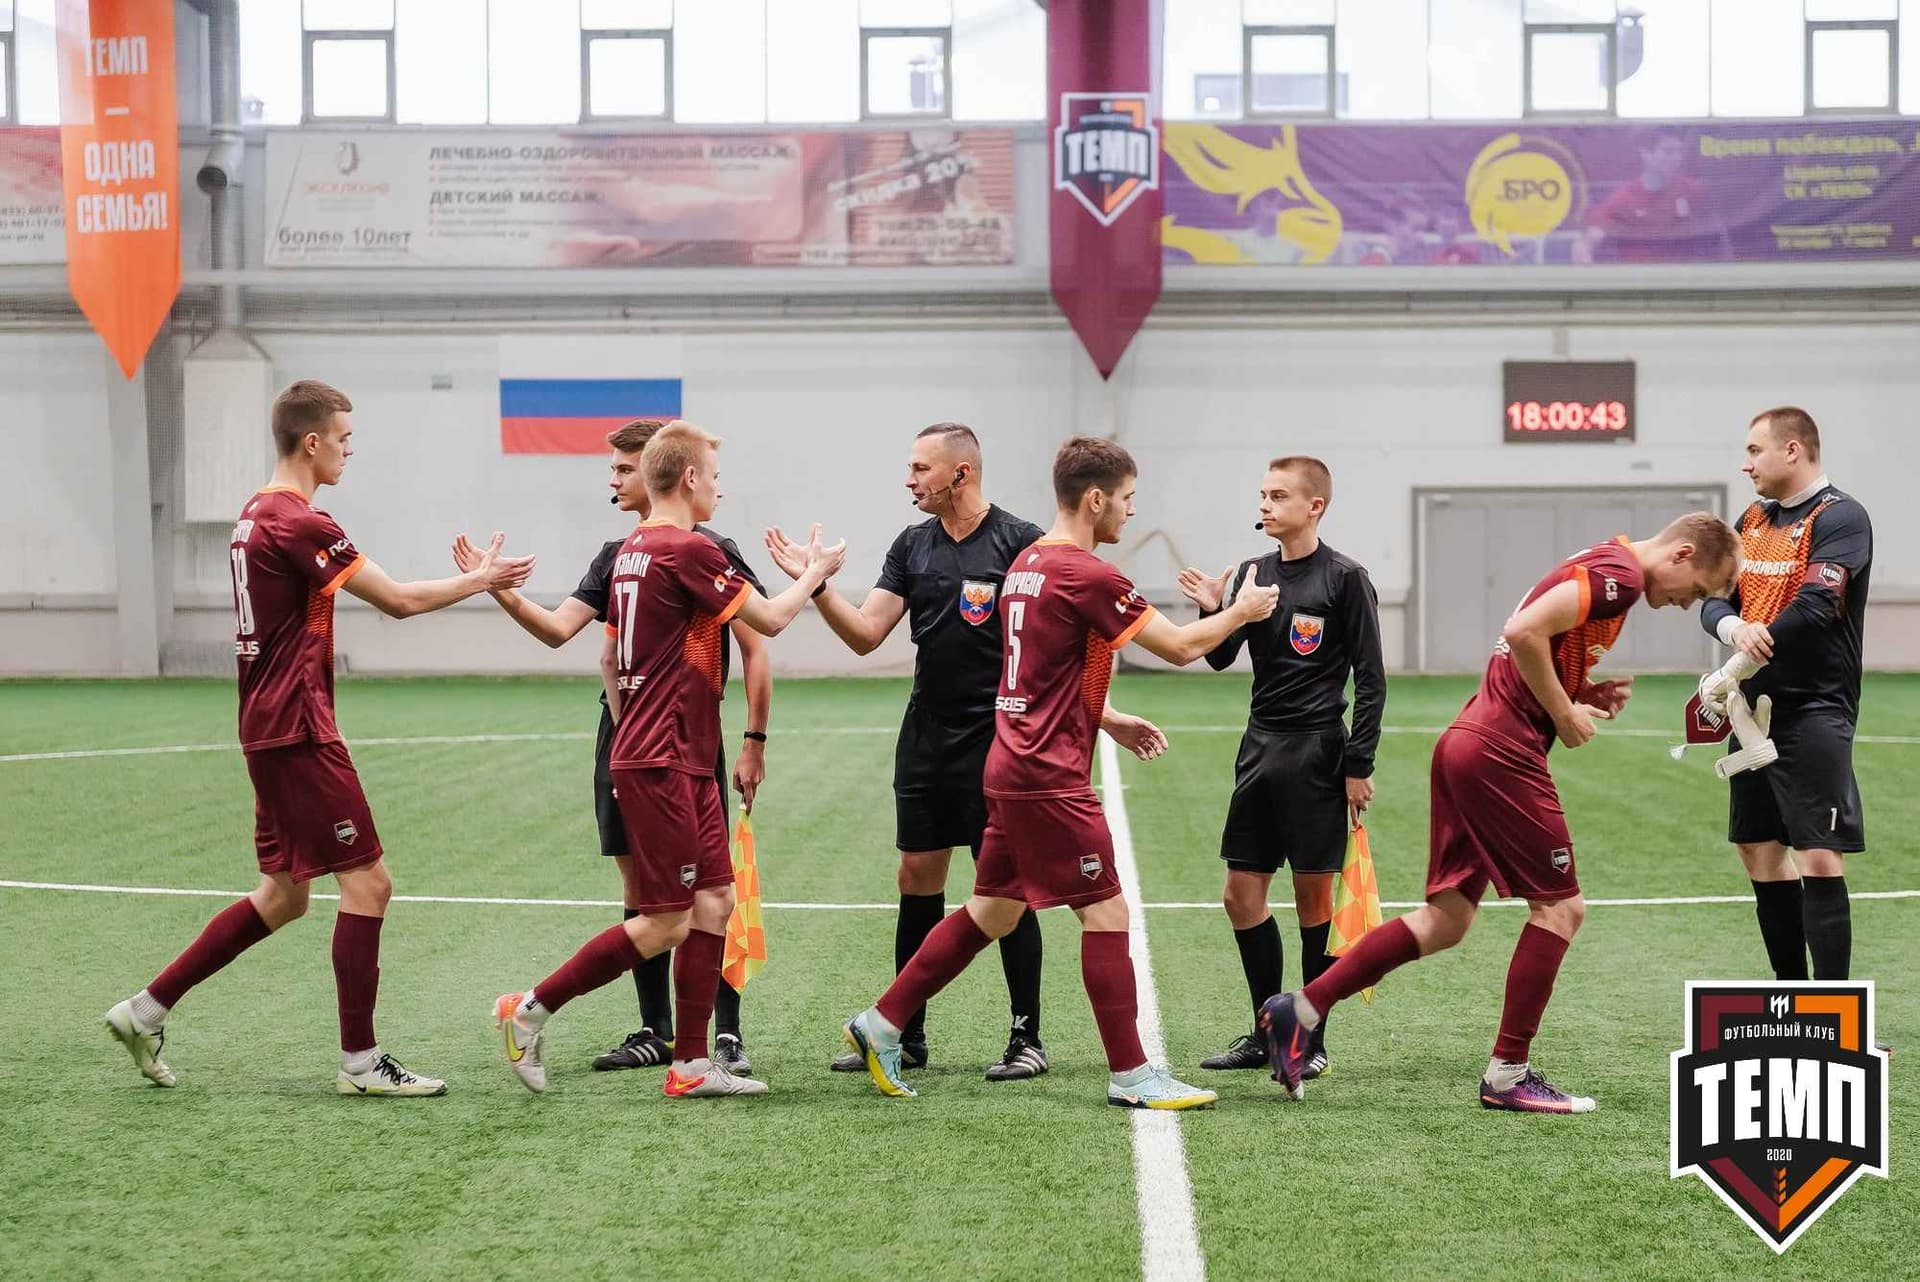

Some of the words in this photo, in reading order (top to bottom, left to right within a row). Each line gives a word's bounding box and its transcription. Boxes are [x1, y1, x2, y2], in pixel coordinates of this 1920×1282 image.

[84, 36, 148, 77] ТЕМП
[84, 140, 155, 186] ОДНА
[1065, 129, 1148, 176] ТЕМП
[430, 189, 513, 205] ДЕТСКИЙ
[1498, 179, 1560, 201] .БРО
[77, 191, 168, 233] СЕМЬЯ!
[278, 226, 343, 245] более
[1507, 401, 1626, 431] 18:00:43
[615, 581, 639, 670] 17
[1007, 601, 1026, 690] 5
[1830, 807, 1838, 831] 1
